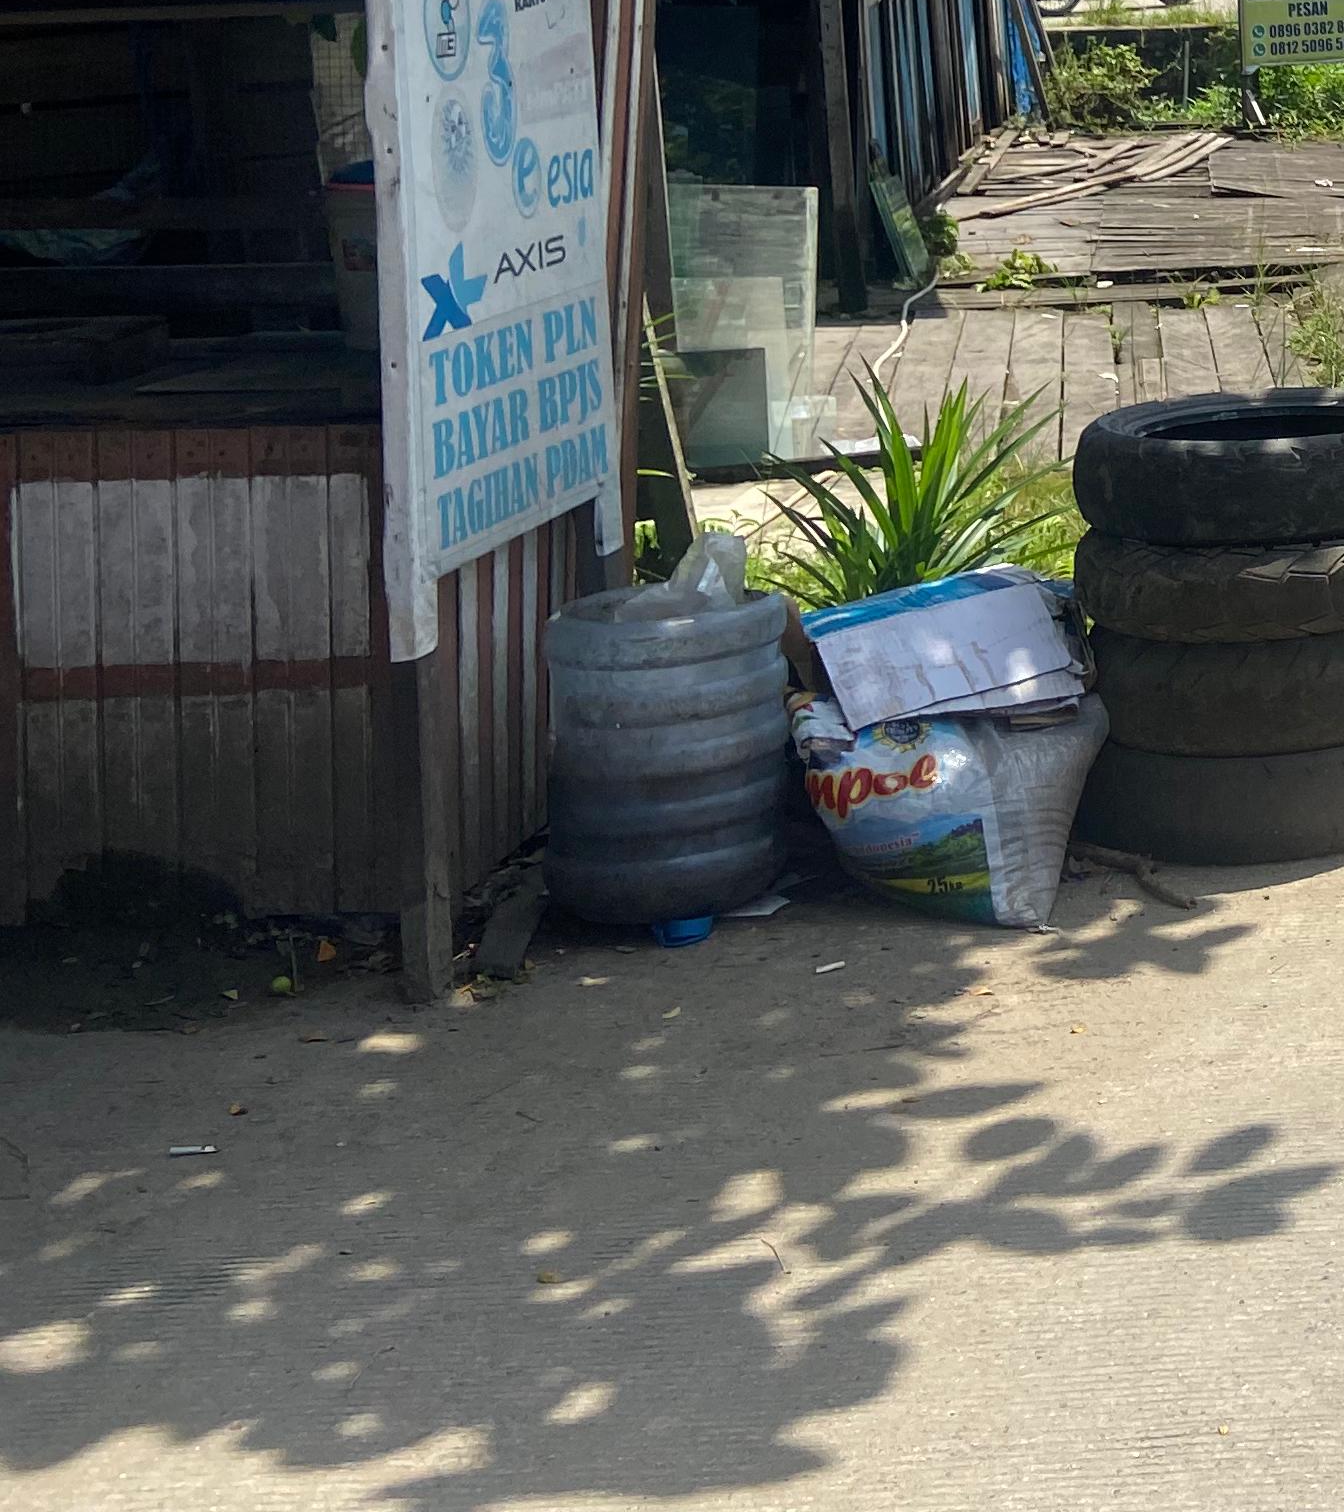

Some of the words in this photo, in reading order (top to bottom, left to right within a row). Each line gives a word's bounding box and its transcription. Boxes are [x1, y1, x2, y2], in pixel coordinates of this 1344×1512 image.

[1269, 22, 1301, 39] 0896
[1304, 20, 1334, 36] 0382
[1288, 1, 1329, 18] PESAN
[1270, 40, 1299, 56] 0812
[1302, 38, 1333, 54] 5096
[547, 147, 594, 209] esia
[420, 241, 488, 341] XL
[493, 235, 567, 285] AXIS
[429, 319, 534, 407] TOKEN
[543, 296, 598, 365] PLN
[432, 389, 529, 480] BAYAR
[537, 358, 602, 434] BPJS
[436, 452, 538, 551] TAGIHAN
[545, 423, 609, 500] PDAM
